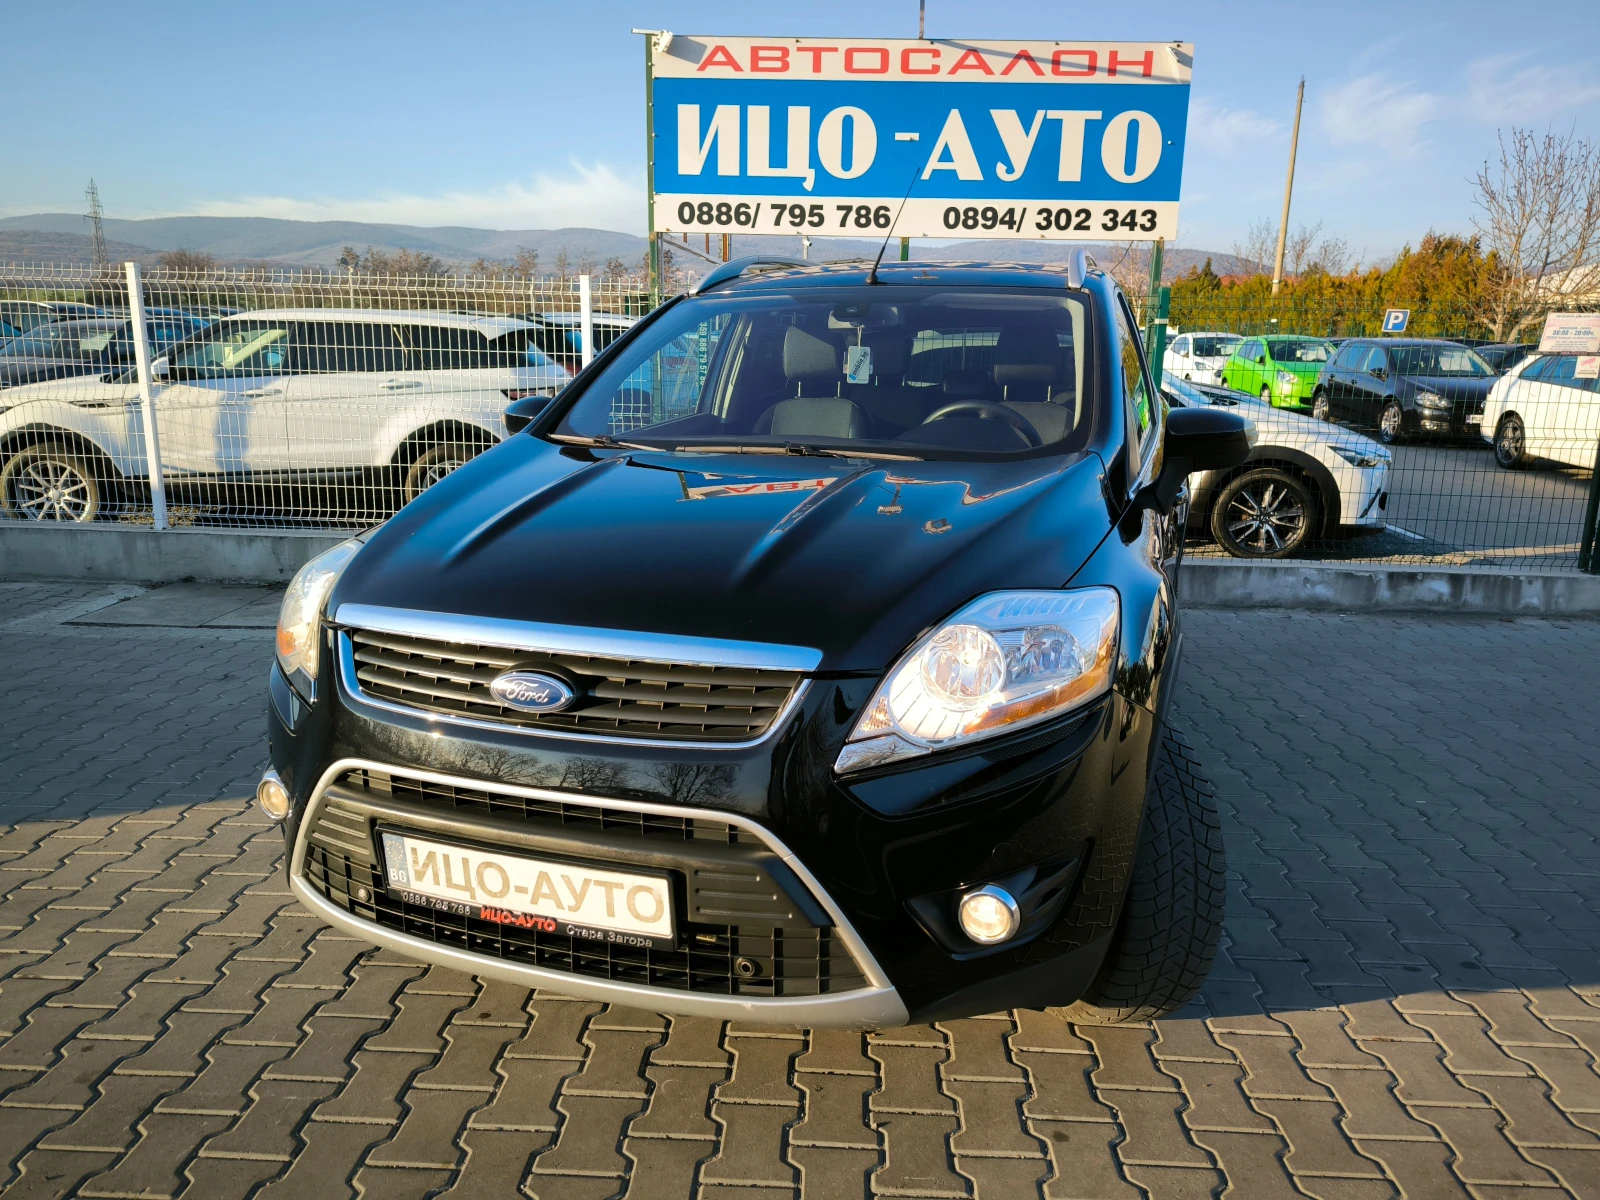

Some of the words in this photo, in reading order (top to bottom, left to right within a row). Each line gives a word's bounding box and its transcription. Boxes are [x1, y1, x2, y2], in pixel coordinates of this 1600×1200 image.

[696, 45, 1154, 78] АВТОСАЛОН
[677, 202, 761, 227] 0886/
[770, 204, 825, 228] 795
[837, 206, 892, 228] 786
[943, 207, 1026, 232] 0894/
[1035, 209, 1092, 232] 302
[1101, 210, 1157, 233] 343
[1387, 312, 1403, 329] P
[505, 680, 550, 704] Ford
[389, 869, 407, 884] BG
[410, 846, 665, 923] ИЦО-АУТО
[402, 892, 427, 906] 0886
[480, 907, 557, 932] ИЦО-АУТО
[566, 924, 604, 940] Стара
[607, 931, 653, 948] Загора
